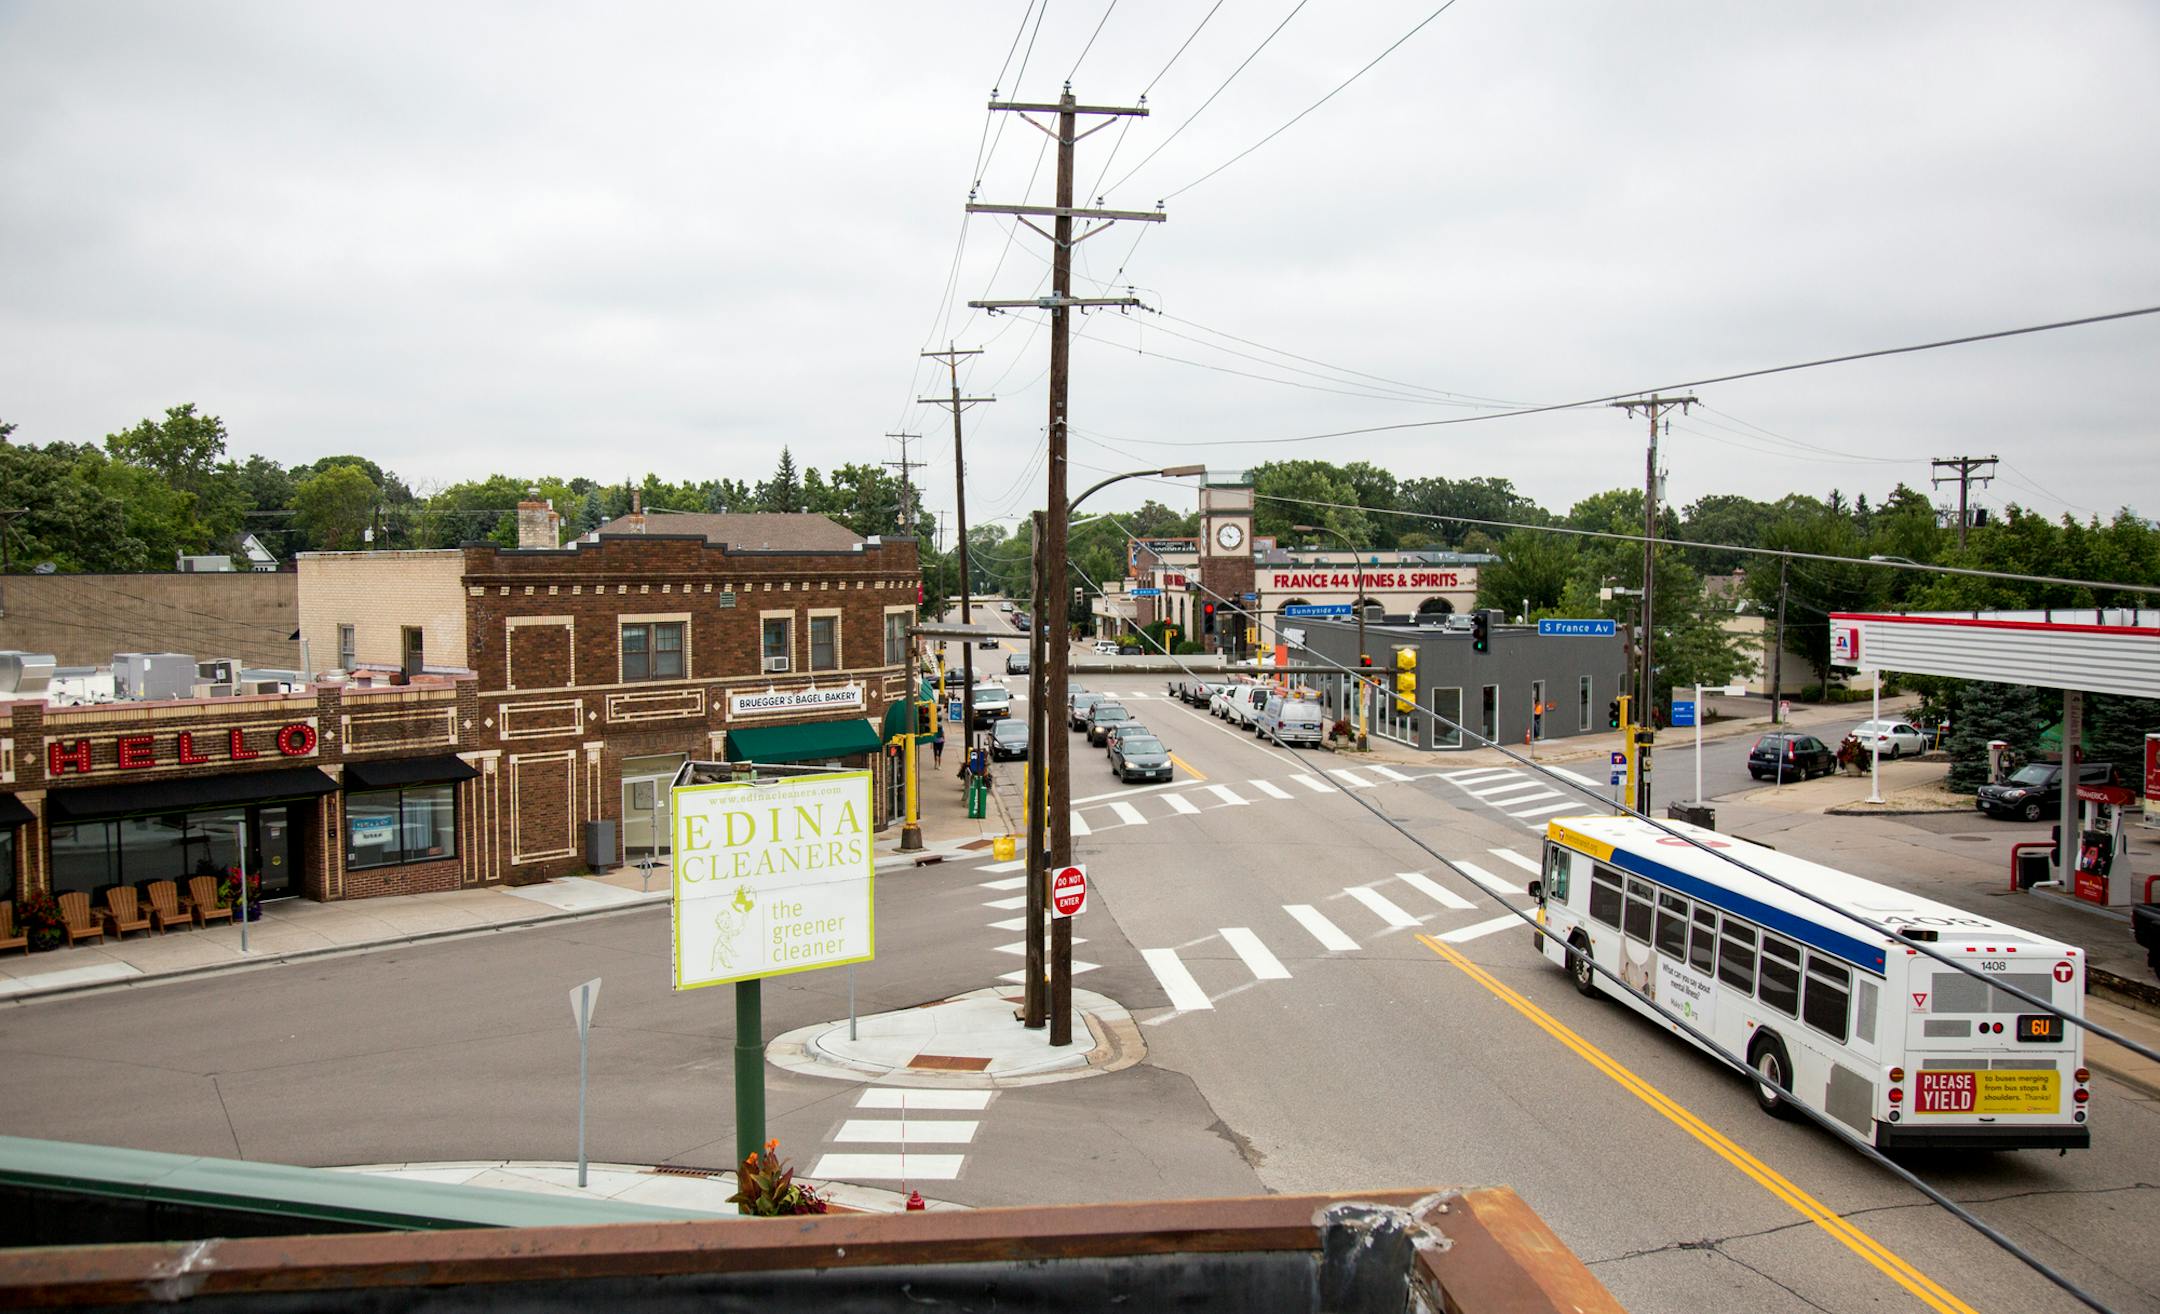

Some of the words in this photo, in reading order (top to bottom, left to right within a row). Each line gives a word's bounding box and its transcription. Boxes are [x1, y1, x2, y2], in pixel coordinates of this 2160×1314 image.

[1274, 574, 1328, 588] FRANCE
[1330, 574, 1349, 588] 44
[1352, 573, 1394, 587] WINES
[1397, 573, 1407, 587] &
[1410, 573, 1458, 587] SPIRITS
[1291, 606, 1332, 615] Sunnyside
[1545, 623, 1551, 632] S
[1556, 623, 1590, 632] France
[1595, 623, 1609, 632] Av
[739, 696, 793, 708] BRUEGGER'S
[796, 694, 822, 704] BAGEL
[825, 691, 856, 701] BAKERY
[49, 723, 317, 776] HELLO
[709, 786, 842, 806] www.edinacleaners.com
[683, 799, 863, 852] EDINA
[681, 838, 863, 884] CLEANERS
[1057, 877, 1068, 886] DO
[1069, 875, 1081, 885] NOT
[772, 899, 802, 920] the
[1060, 896, 1080, 907] ENTER
[772, 916, 847, 945] greener
[772, 938, 845, 962] cleaner
[1981, 961, 2006, 971] 1408
[2031, 1019, 2050, 1036] 6U
[1923, 1075, 1972, 1089] PLEASE
[2018, 1075, 2049, 1083] merging
[1923, 1091, 1971, 1110] YIELD
[1984, 1093, 2021, 1101] shoulders.
[2025, 1093, 2052, 1101] Thanks!
